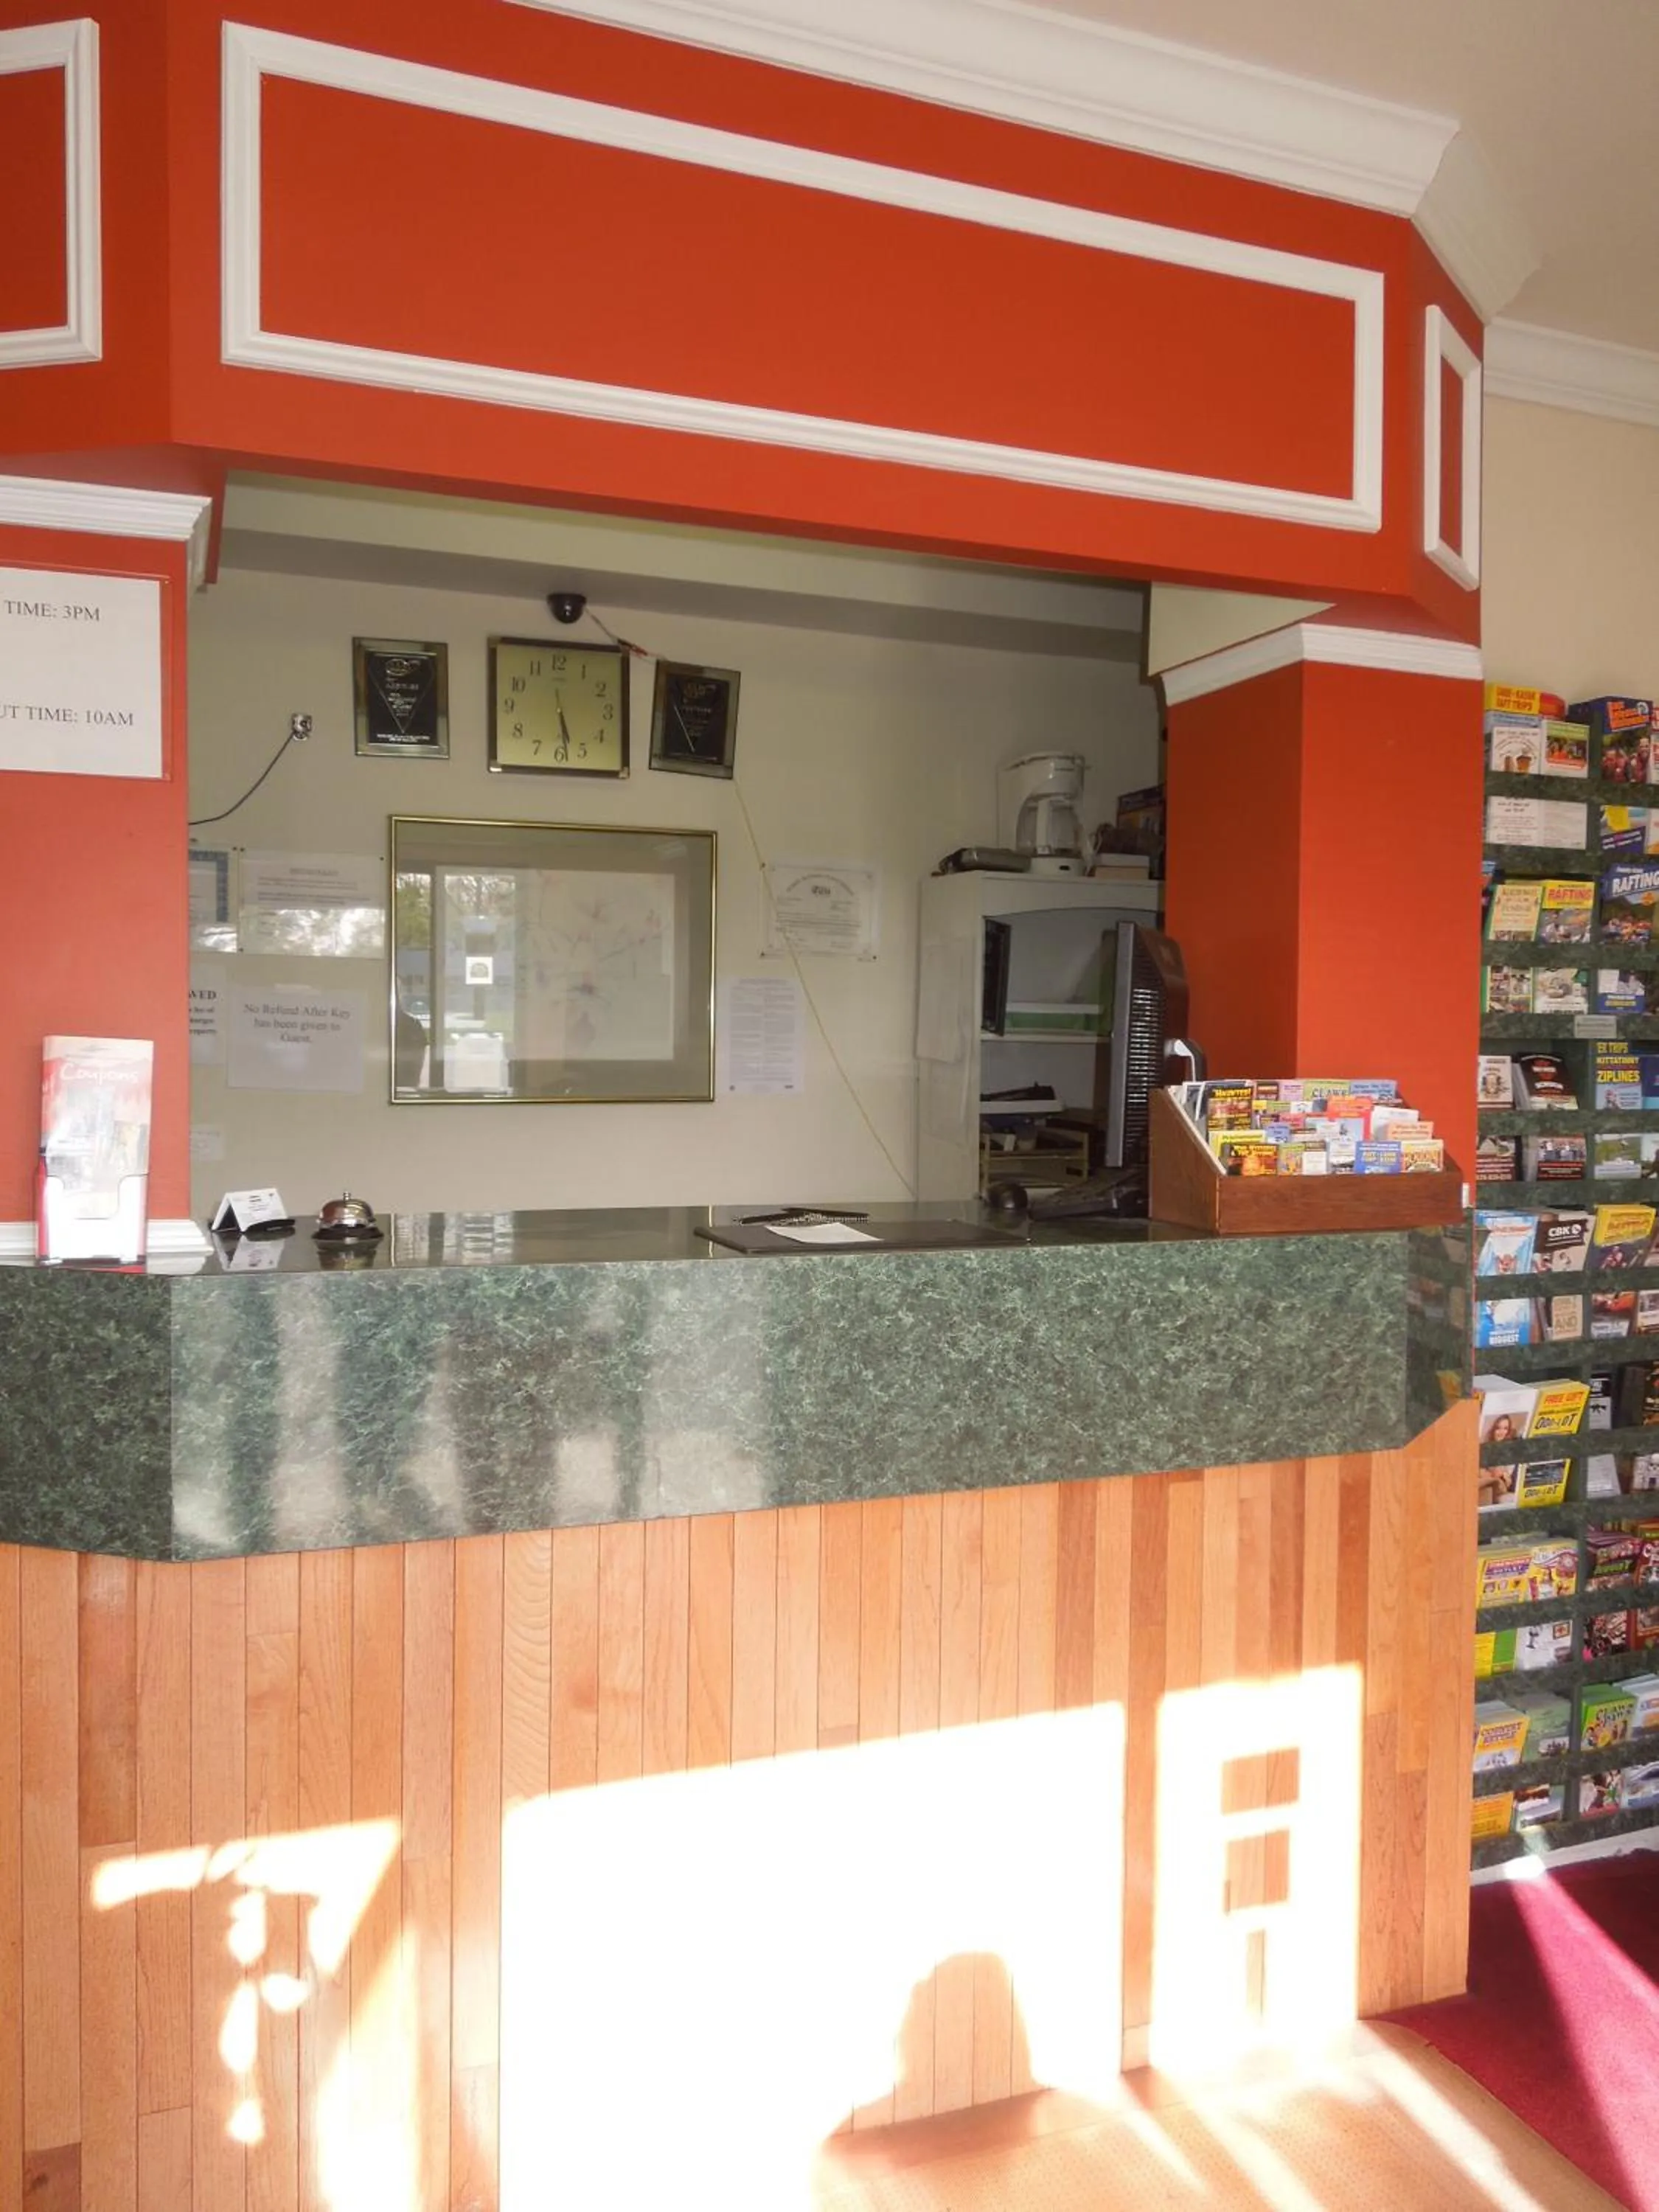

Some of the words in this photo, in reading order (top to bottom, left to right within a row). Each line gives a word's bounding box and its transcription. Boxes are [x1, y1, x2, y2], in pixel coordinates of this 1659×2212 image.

[4, 599, 57, 618] TIME:
[63, 605, 100, 621] 3PM
[530, 660, 541, 676] 11
[552, 655, 567, 671] 12
[581, 664, 587, 680] 1
[512, 676, 526, 693] 10
[595, 681, 607, 698] 2
[505, 698, 515, 714] 9
[602, 703, 613, 720] 3
[25, 706, 77, 723] TIME:
[86, 709, 134, 726] 10AM
[512, 722, 524, 738] 8
[594, 728, 605, 743] 4
[532, 739, 542, 756] 7
[554, 745, 565, 762] 6
[577, 742, 588, 759] 5
[1612, 870, 1659, 895] RAFTING
[243, 1004, 259, 1014] No
[262, 1004, 299, 1016] Refund
[303, 1006, 327, 1017] After
[330, 1008, 351, 1020] Key
[254, 1018, 271, 1029] has
[274, 1019, 297, 1029] been
[299, 1021, 327, 1032] given
[59, 1062, 139, 1085] Coupons
[1596, 1070, 1641, 1084] ZIPLINES
[1548, 1225, 1571, 1238] CBK
[1545, 1394, 1564, 1405] FREE
